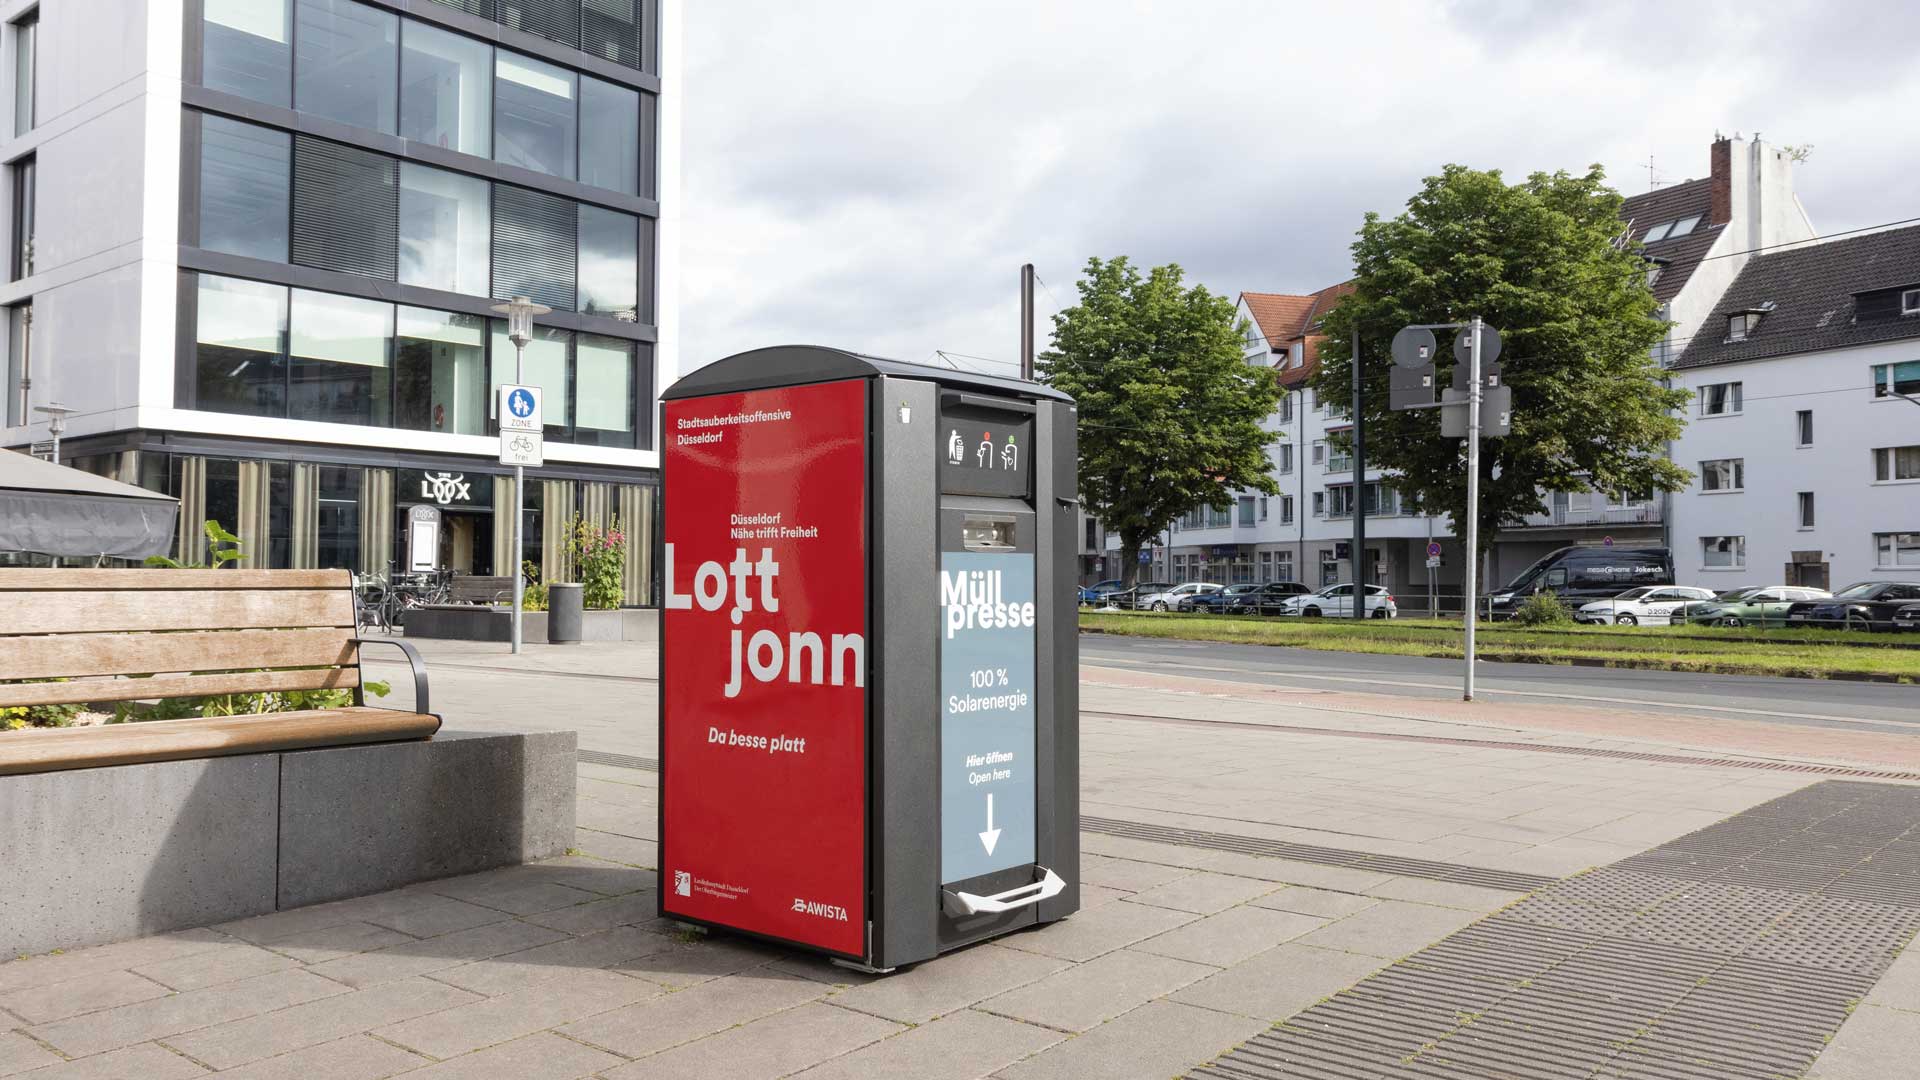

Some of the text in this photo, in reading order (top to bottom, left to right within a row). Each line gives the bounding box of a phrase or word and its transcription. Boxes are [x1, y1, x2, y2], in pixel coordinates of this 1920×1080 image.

[511, 418, 533, 427] ZONE
[677, 409, 792, 429] Stadtsauberkeitsoffensive
[677, 431, 723, 446] Düsseldorf
[515, 453, 529, 461] frei
[731, 512, 781, 525] Düsseldorf
[731, 525, 818, 539] Nähe trifft Freiheit
[665, 543, 779, 612] Lott
[1635, 565, 1663, 573] Jokesch
[941, 570, 1002, 606] Müll
[947, 602, 1035, 639] presse
[725, 607, 864, 697] jonn
[970, 668, 1008, 688] 100 %
[949, 689, 1027, 713] Solarenergie
[708, 727, 806, 754] Da besse platt
[966, 751, 1013, 767] Hier öffnen
[969, 767, 1011, 786] Open here
[806, 901, 848, 921] AWISTA
